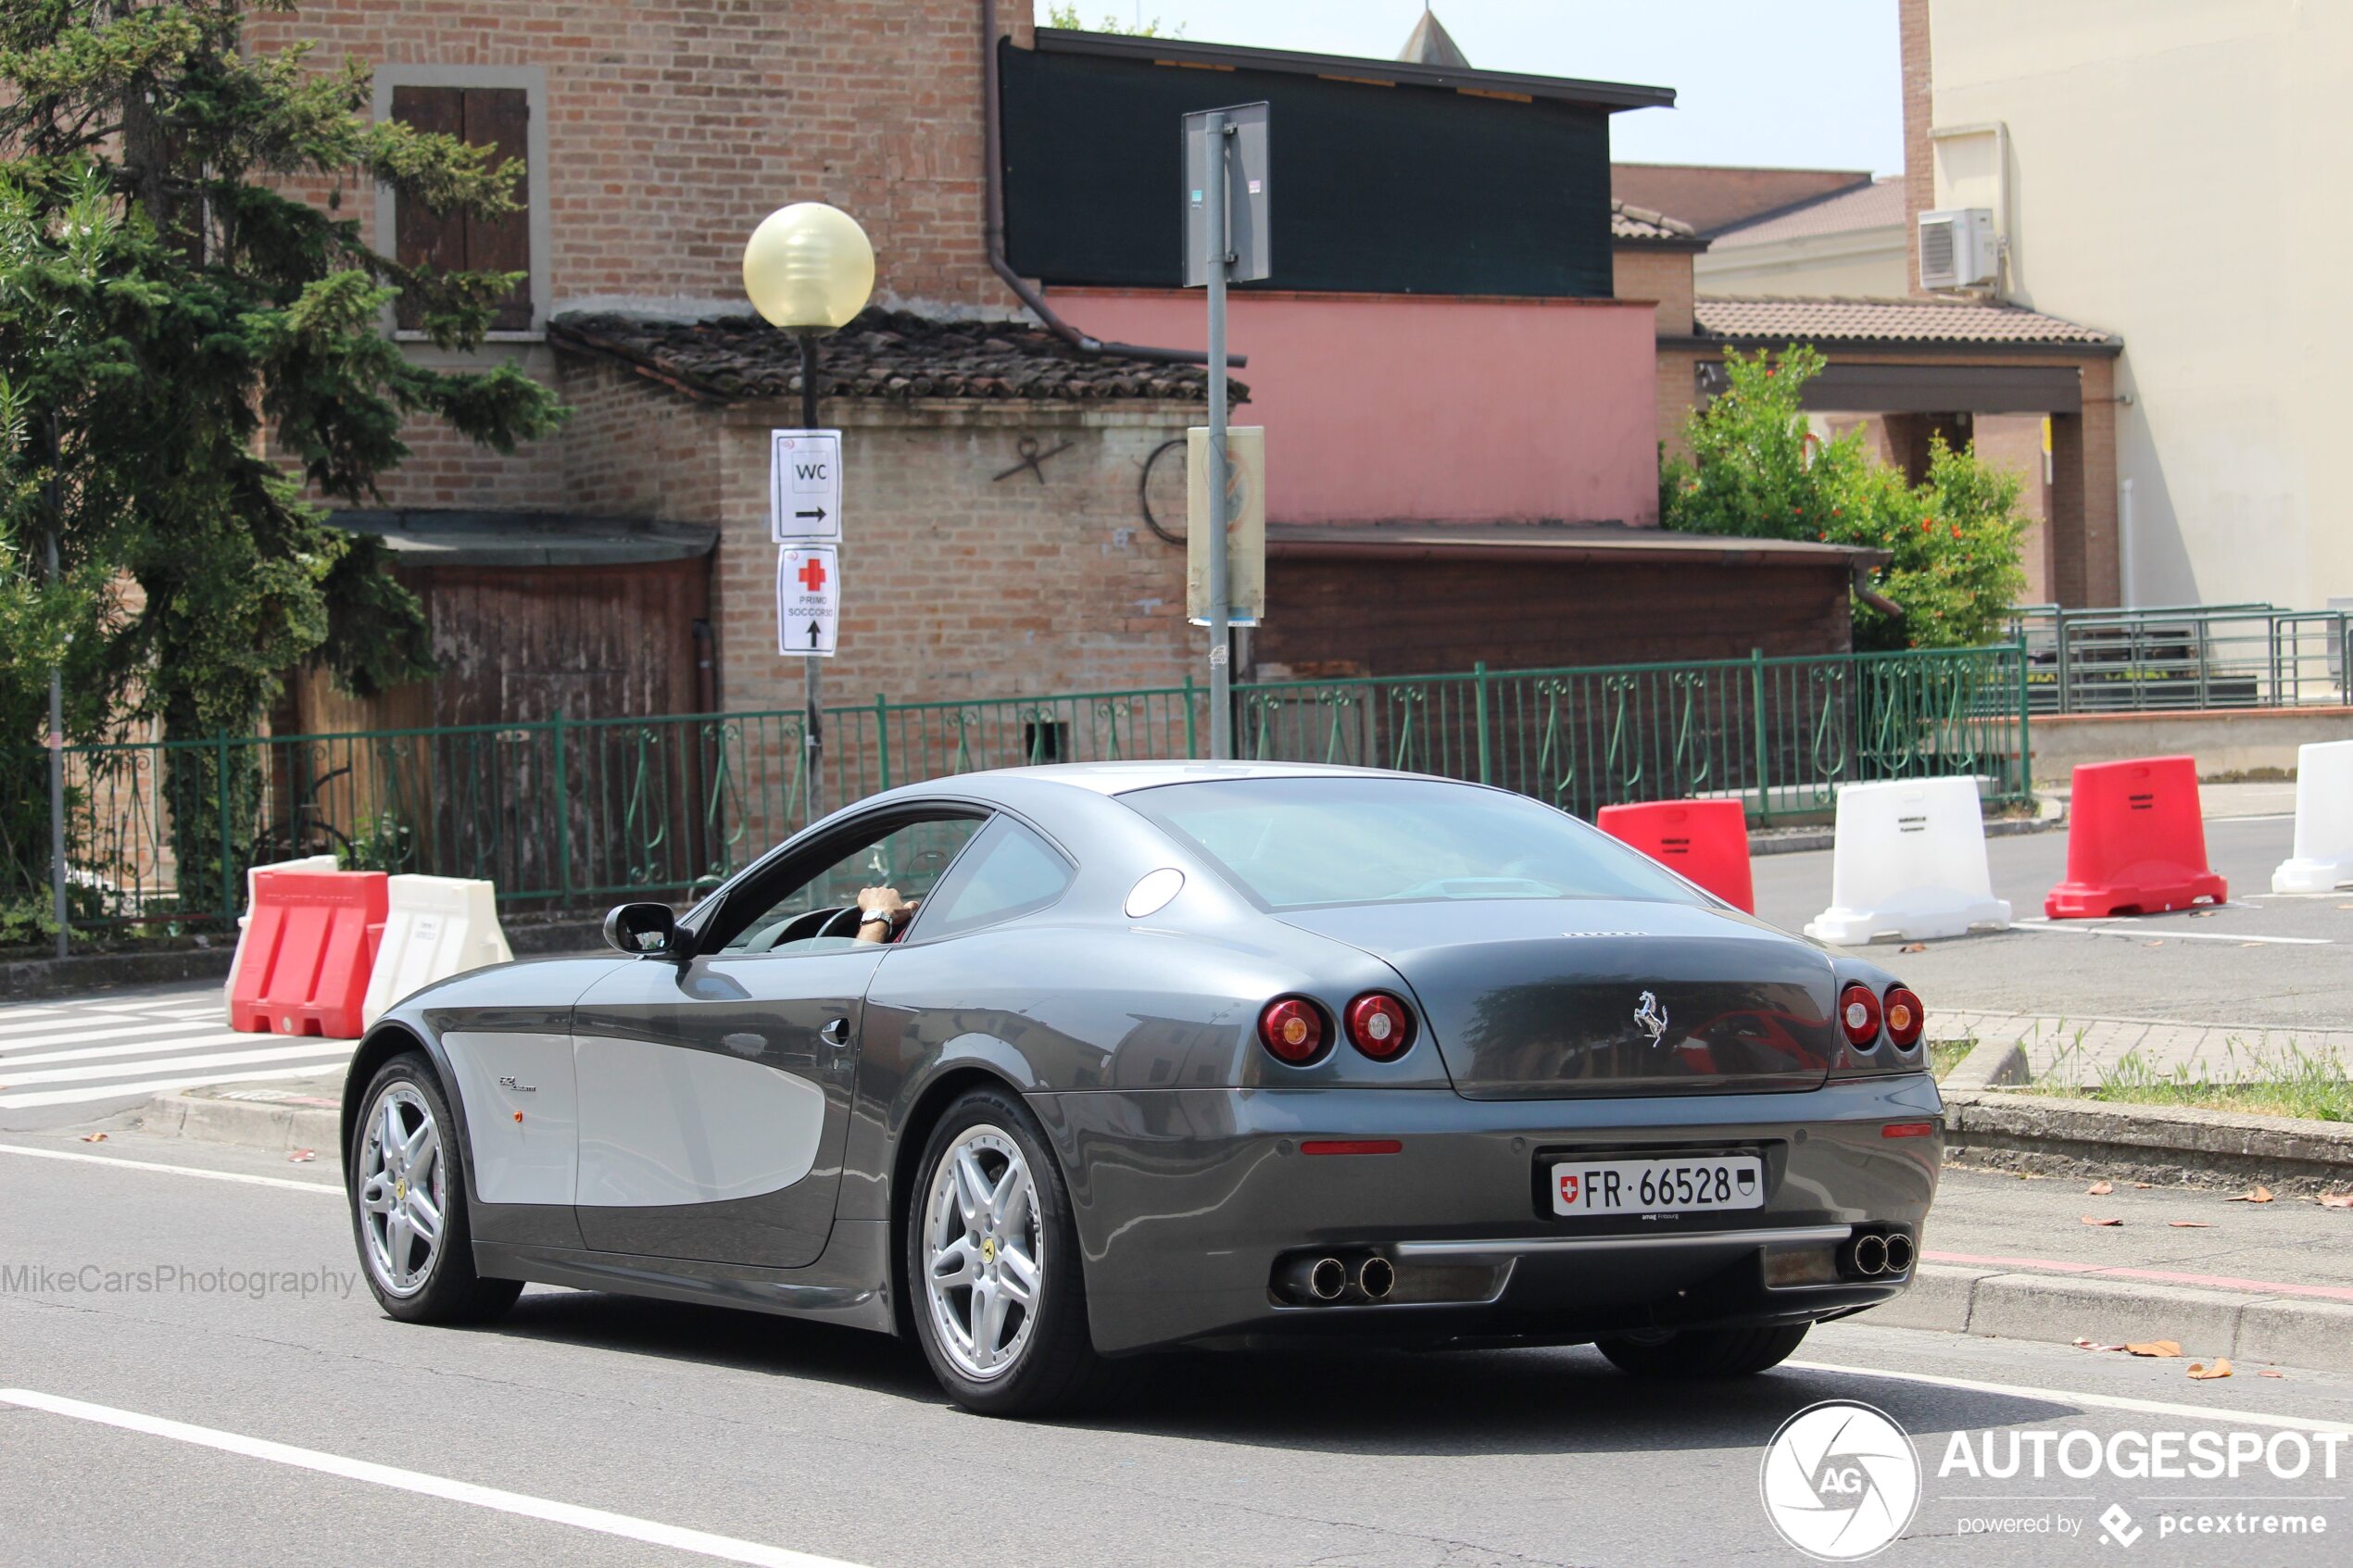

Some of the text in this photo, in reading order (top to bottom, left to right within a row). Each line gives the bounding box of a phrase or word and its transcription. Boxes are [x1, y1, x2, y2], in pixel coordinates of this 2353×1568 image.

[796, 464, 827, 480] WC
[799, 596, 827, 605] PRIMO
[787, 608, 834, 617] SOCCORSO
